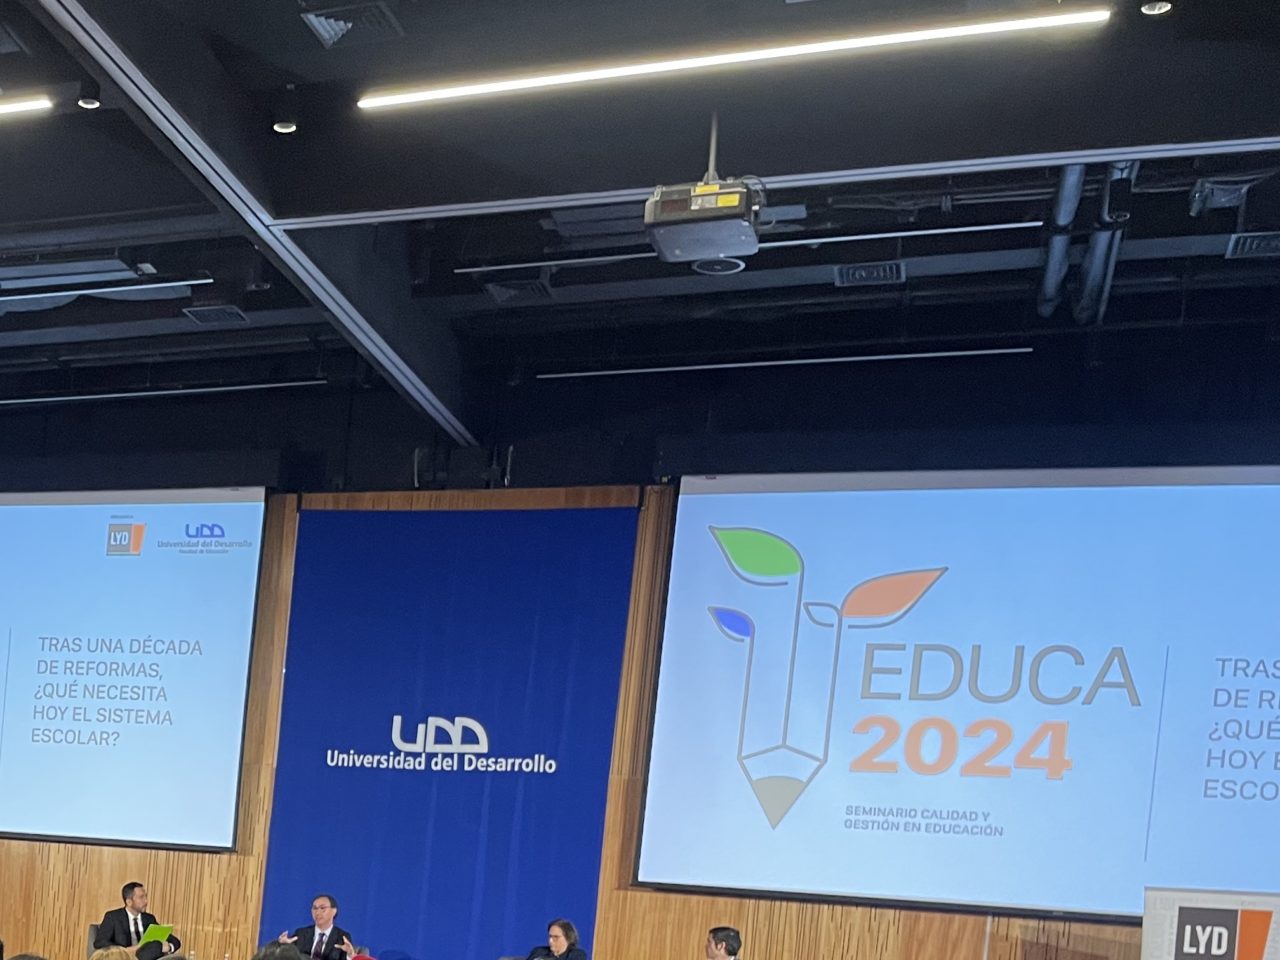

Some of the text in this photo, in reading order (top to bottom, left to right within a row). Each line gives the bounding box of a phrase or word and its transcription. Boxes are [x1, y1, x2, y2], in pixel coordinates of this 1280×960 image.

[110, 532, 128, 544] LYD
[38, 635, 203, 656] TRAS UNA DÉCADA
[36, 660, 164, 680] DE REFORMAS,
[860, 643, 1142, 707] EDUCA
[34, 680, 168, 702] ¿QUÉ NECESITA
[1213, 688, 1250, 708] DE
[32, 705, 173, 726] HOY EL SISTEMA
[32, 728, 120, 746] ESCOLAR?
[849, 715, 1072, 780] 2024
[326, 749, 557, 774] Universidad del Desarrollo
[1206, 748, 1266, 770] HOY
[846, 805, 990, 822] SEMINARIO CALIDAD Y
[844, 818, 1004, 837] GESTIÓN EN EDUCACIÓN
[1182, 924, 1228, 956] LYD
